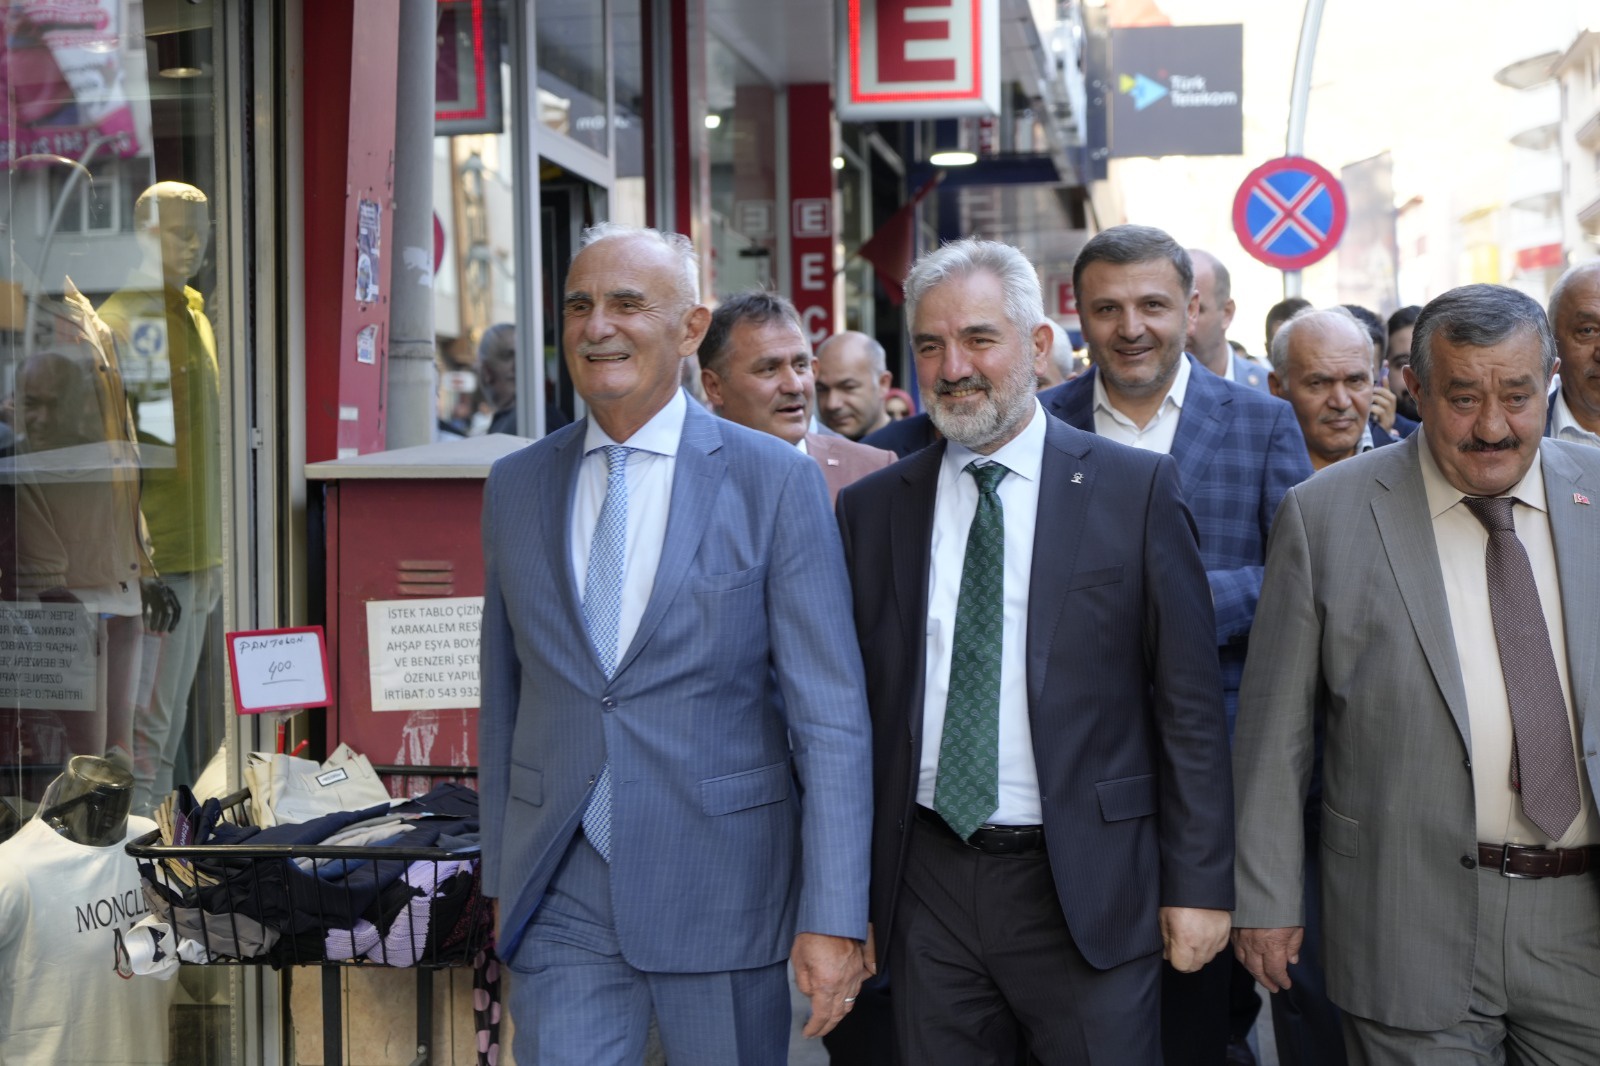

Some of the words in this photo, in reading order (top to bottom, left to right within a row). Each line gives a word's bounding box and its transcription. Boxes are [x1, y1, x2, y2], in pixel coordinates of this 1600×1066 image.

[878, 0, 955, 82] E
[1170, 91, 1237, 107] Telekom
[388, 607, 416, 619] İSTEK
[419, 606, 454, 618] TABLO
[391, 622, 455, 635] KARAKALEM
[386, 640, 422, 653] AHŞAP
[424, 639, 451, 652] EŞYA
[394, 656, 408, 668] VE
[411, 654, 455, 667] BENZERİ
[404, 671, 445, 683] ÖZENLE
[437, 687, 457, 698] 543
